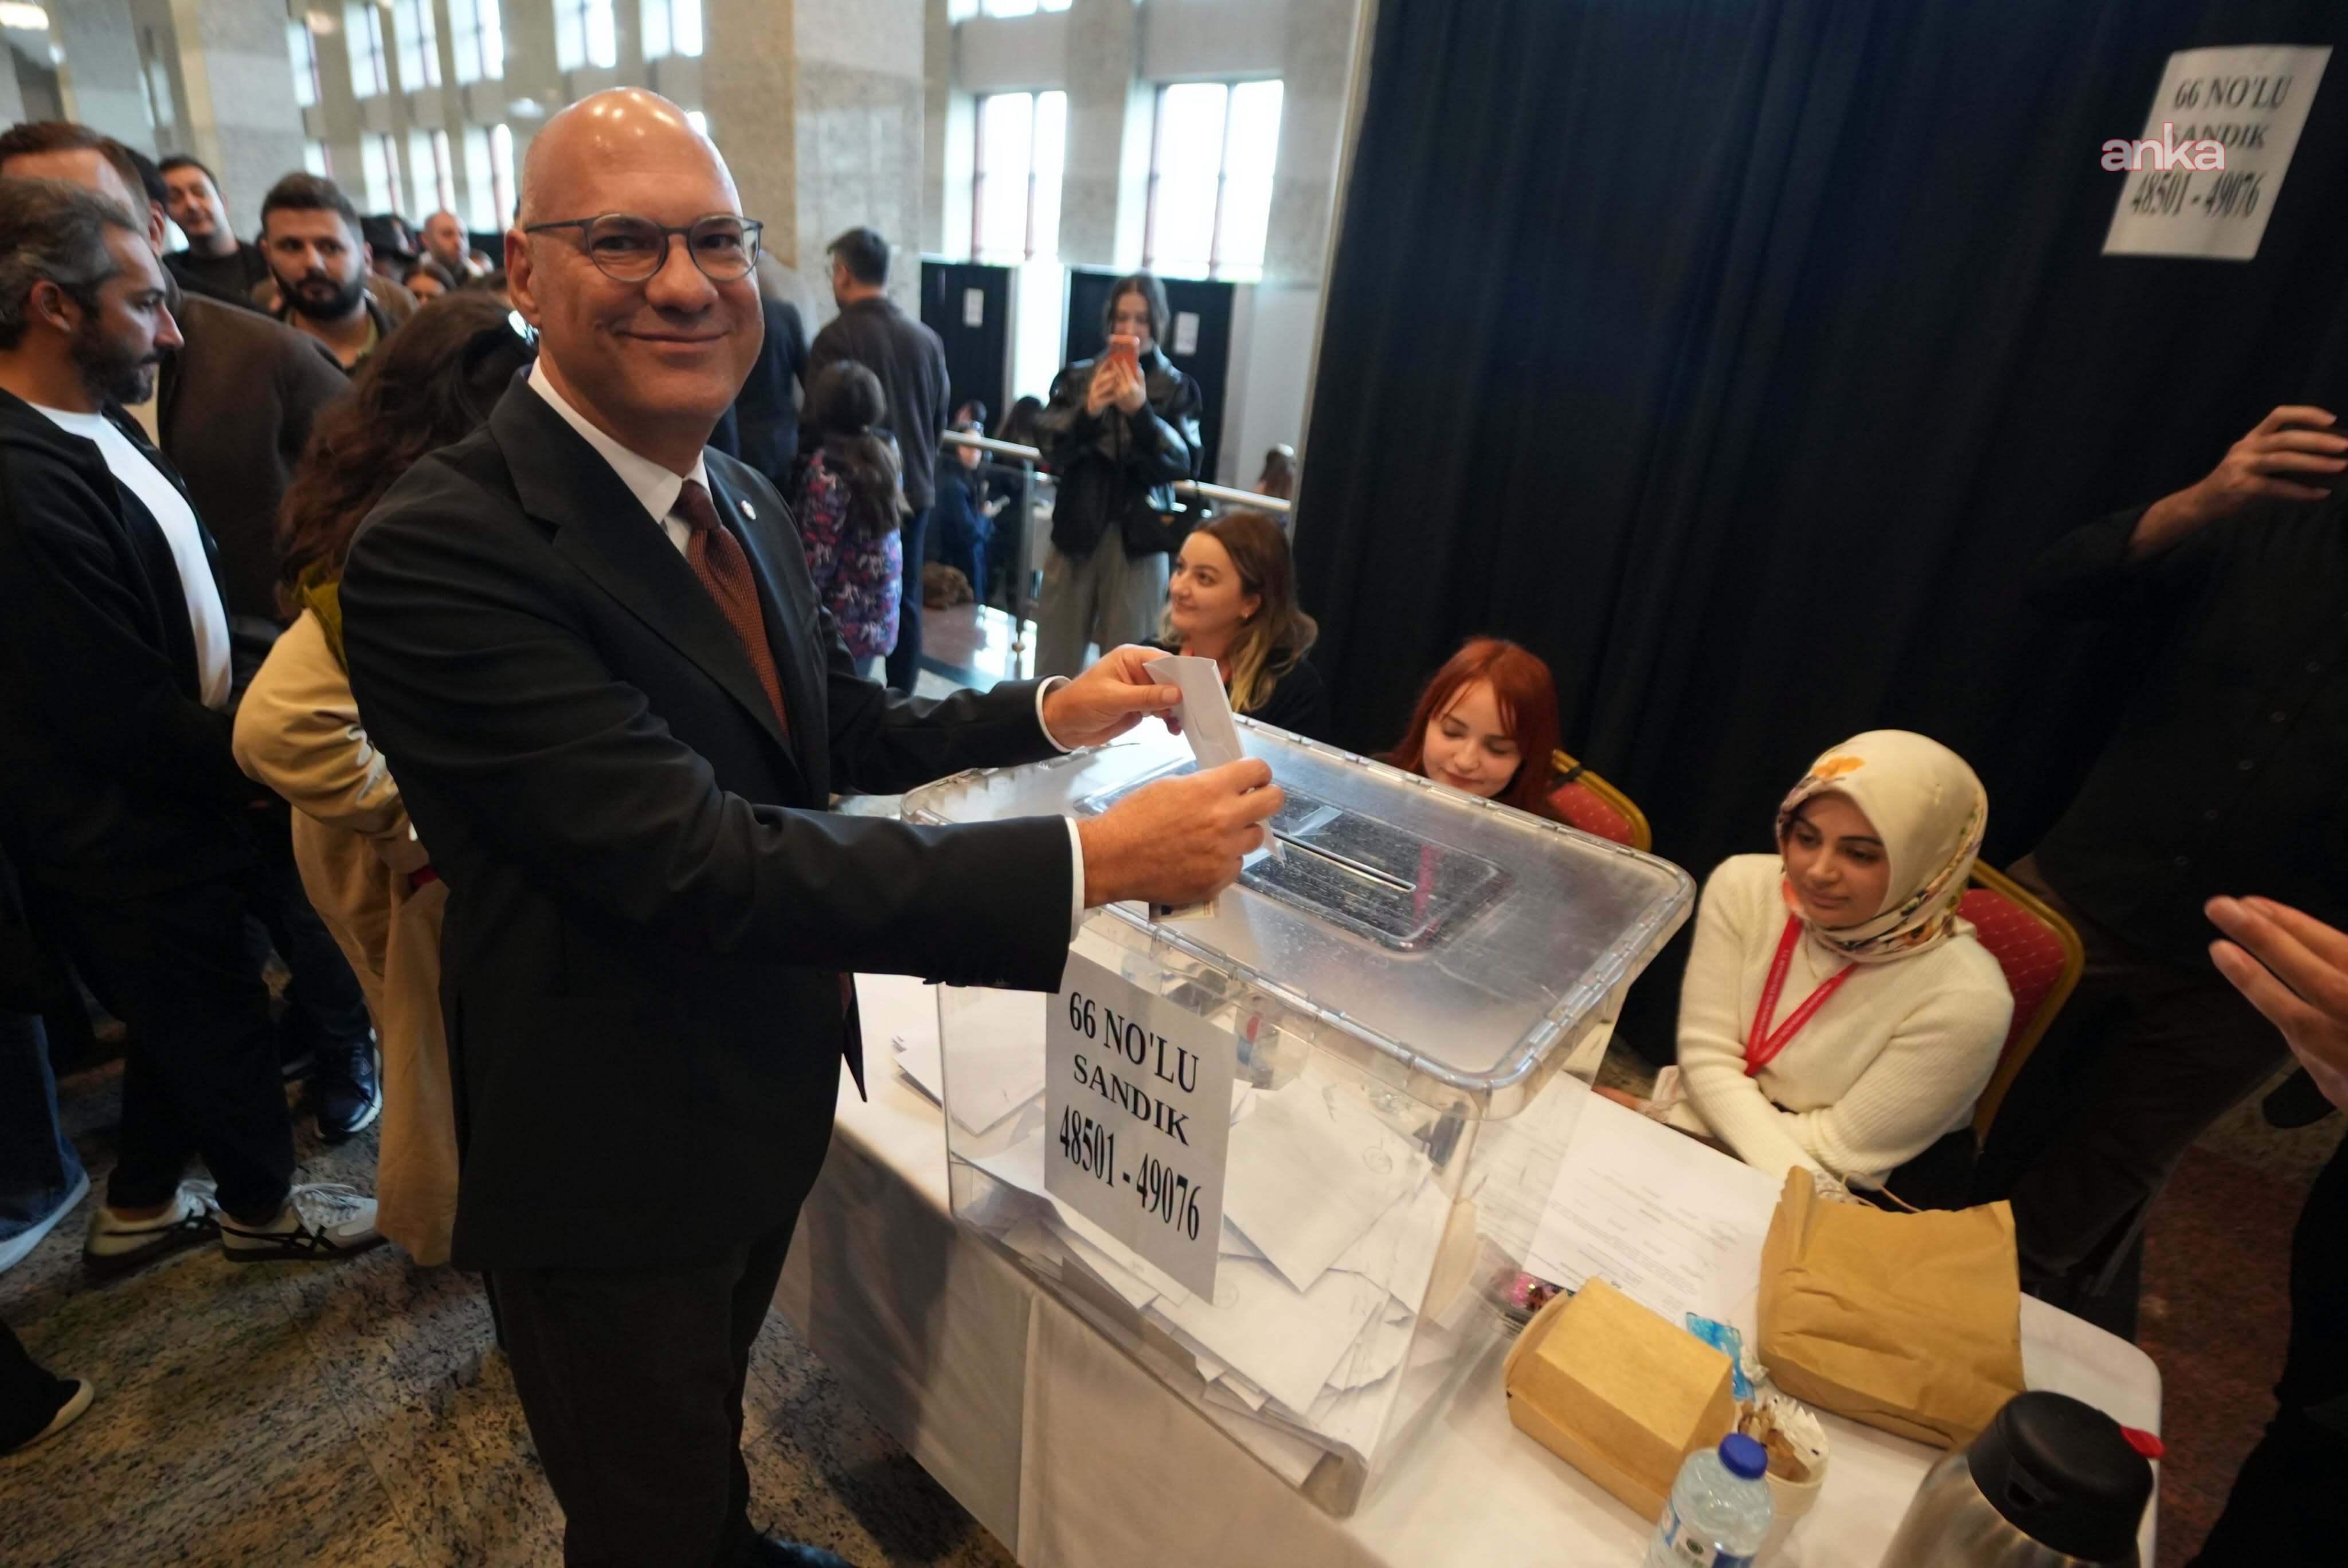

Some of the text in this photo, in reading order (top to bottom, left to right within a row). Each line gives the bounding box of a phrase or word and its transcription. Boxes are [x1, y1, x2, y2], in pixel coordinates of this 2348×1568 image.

[2174, 76, 2292, 109] 66 NO'LU
[1069, 991, 1199, 1093] 66 NO'LU
[1074, 1055, 1189, 1146] SANDIK
[1059, 1104, 1202, 1241] 48501 - 49076
